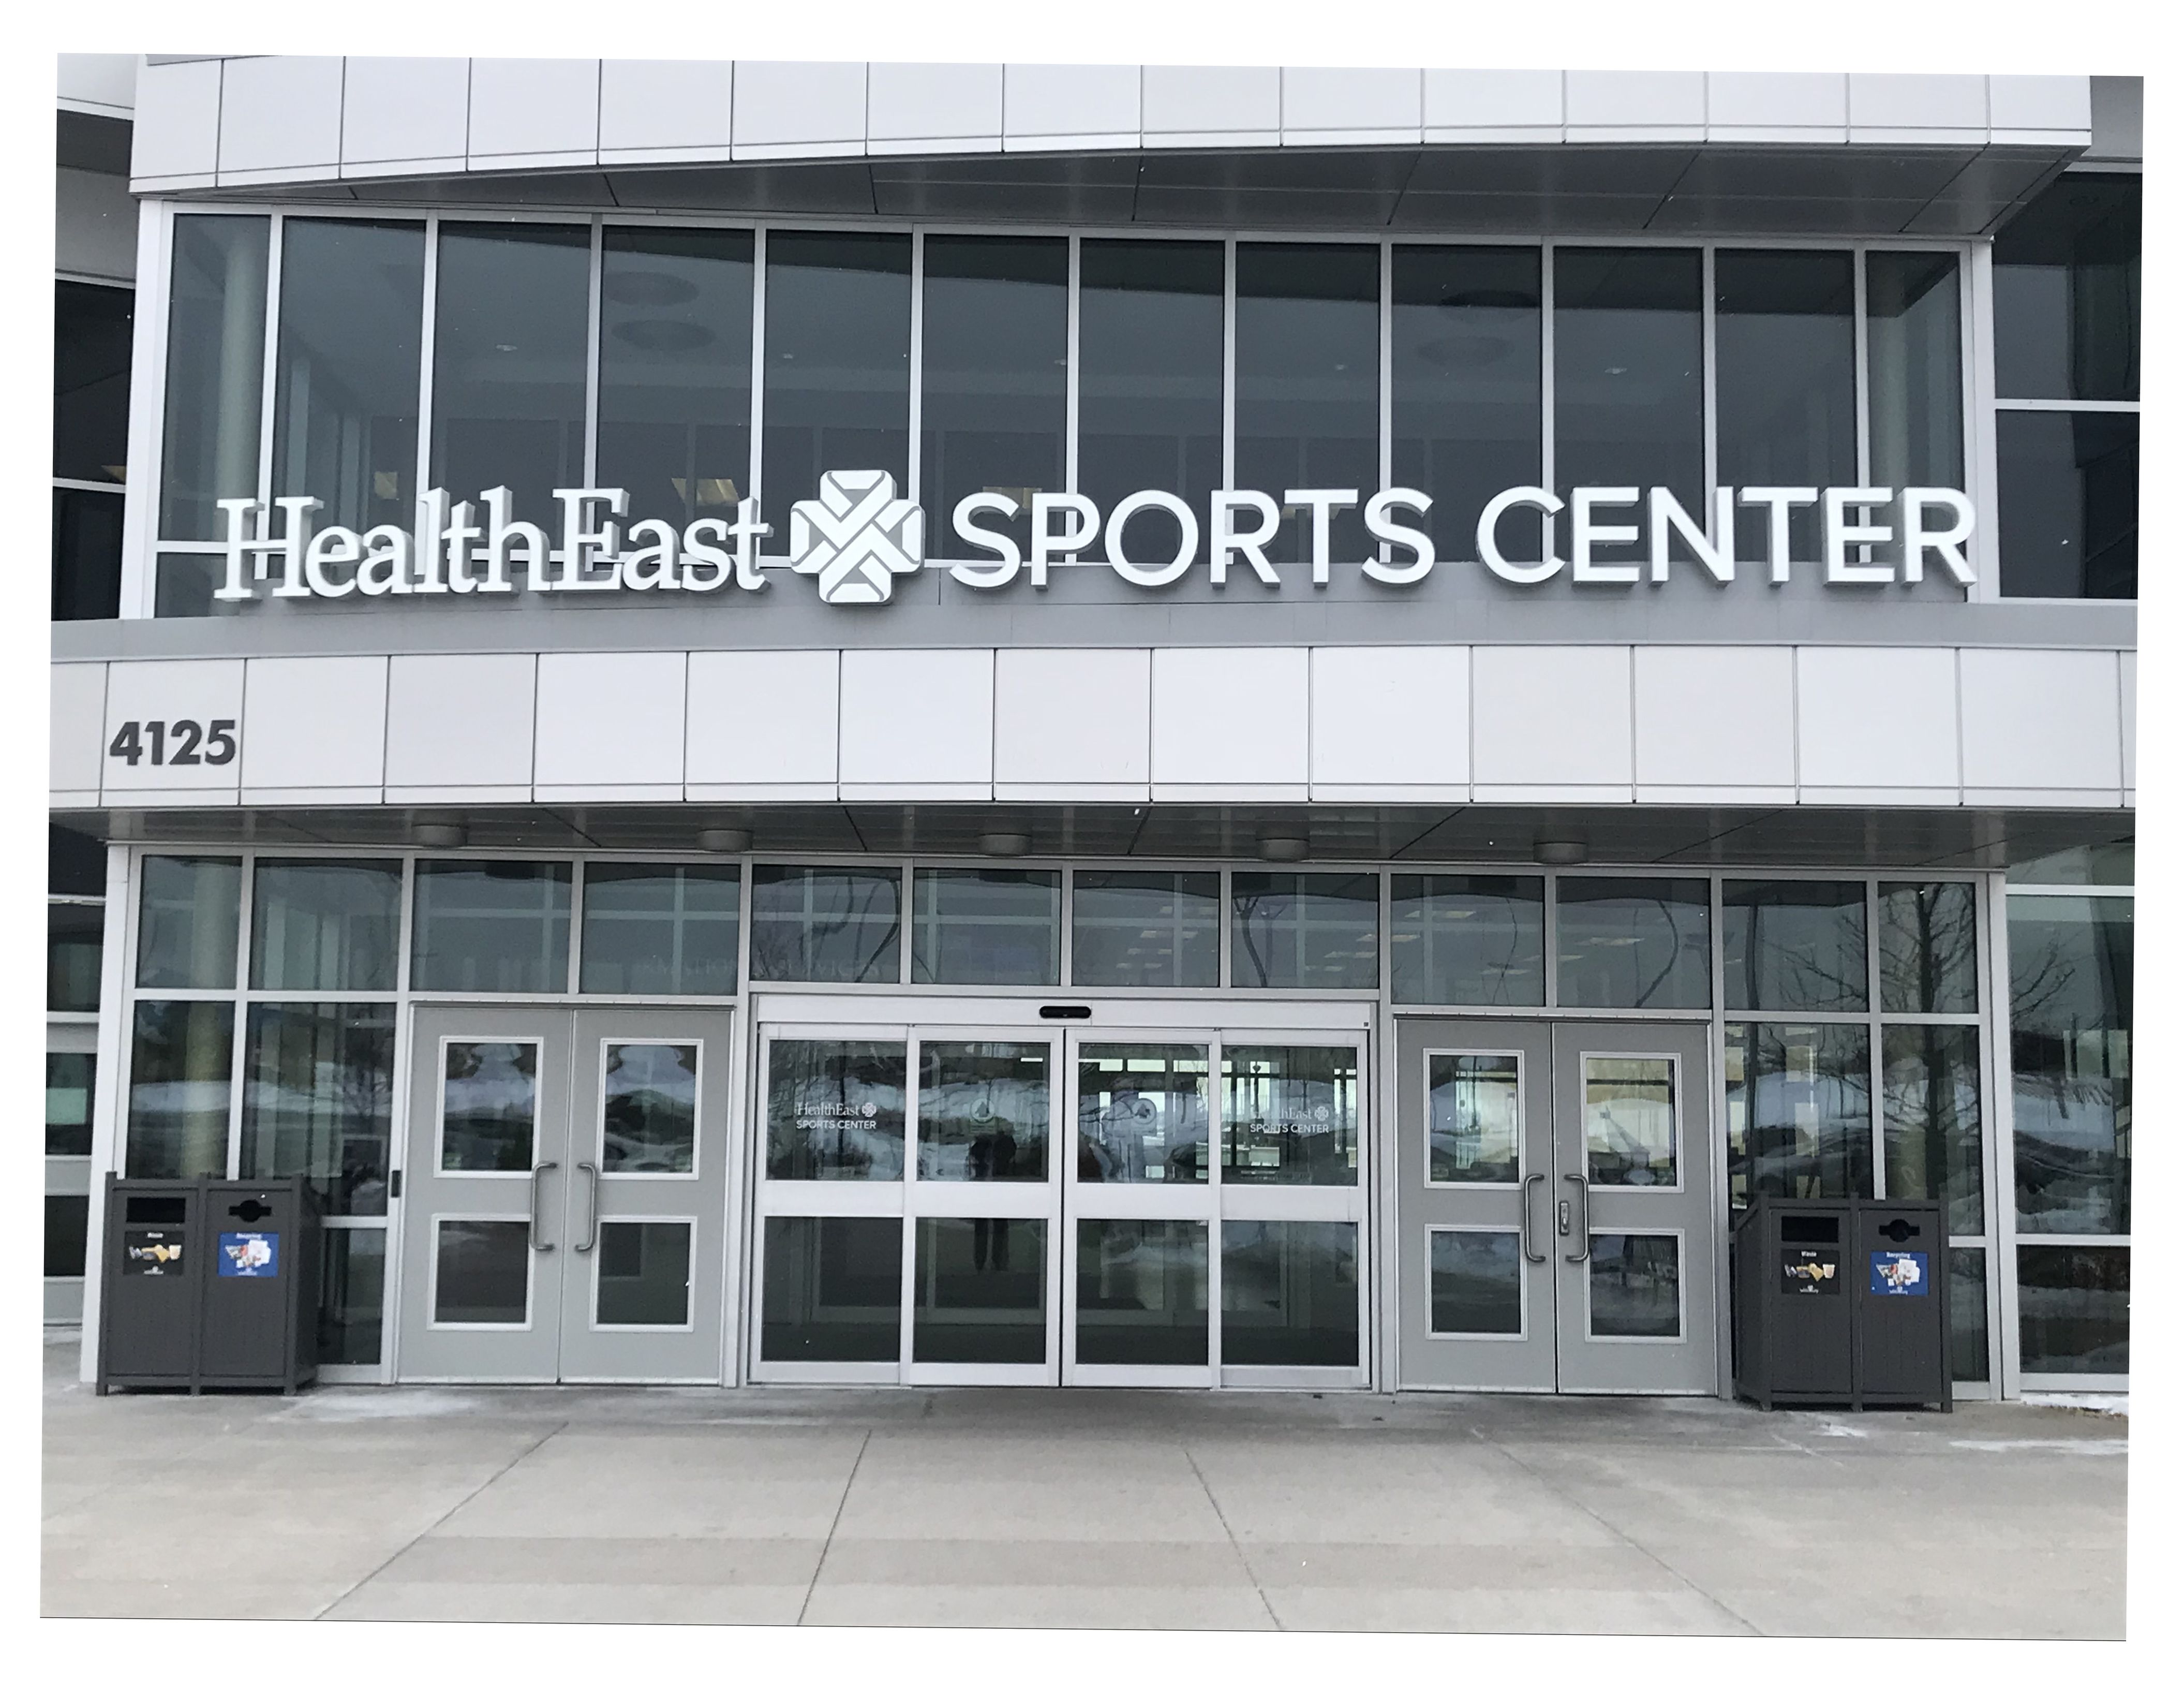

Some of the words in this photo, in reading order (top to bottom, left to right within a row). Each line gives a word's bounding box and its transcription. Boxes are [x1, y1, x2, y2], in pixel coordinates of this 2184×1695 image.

[213, 485, 772, 599] HealthEast
[949, 490, 1436, 588] SPORTS
[1476, 485, 1978, 587] CENTER
[109, 719, 236, 765] 4125
[797, 1102, 859, 1116] HealthEast
[1256, 1107, 1312, 1119] hEast
[796, 1120, 836, 1129] SPORTS
[837, 1120, 876, 1129] CENTER
[1250, 1123, 1288, 1133] SPORTS
[1290, 1123, 1329, 1133] CENTER
